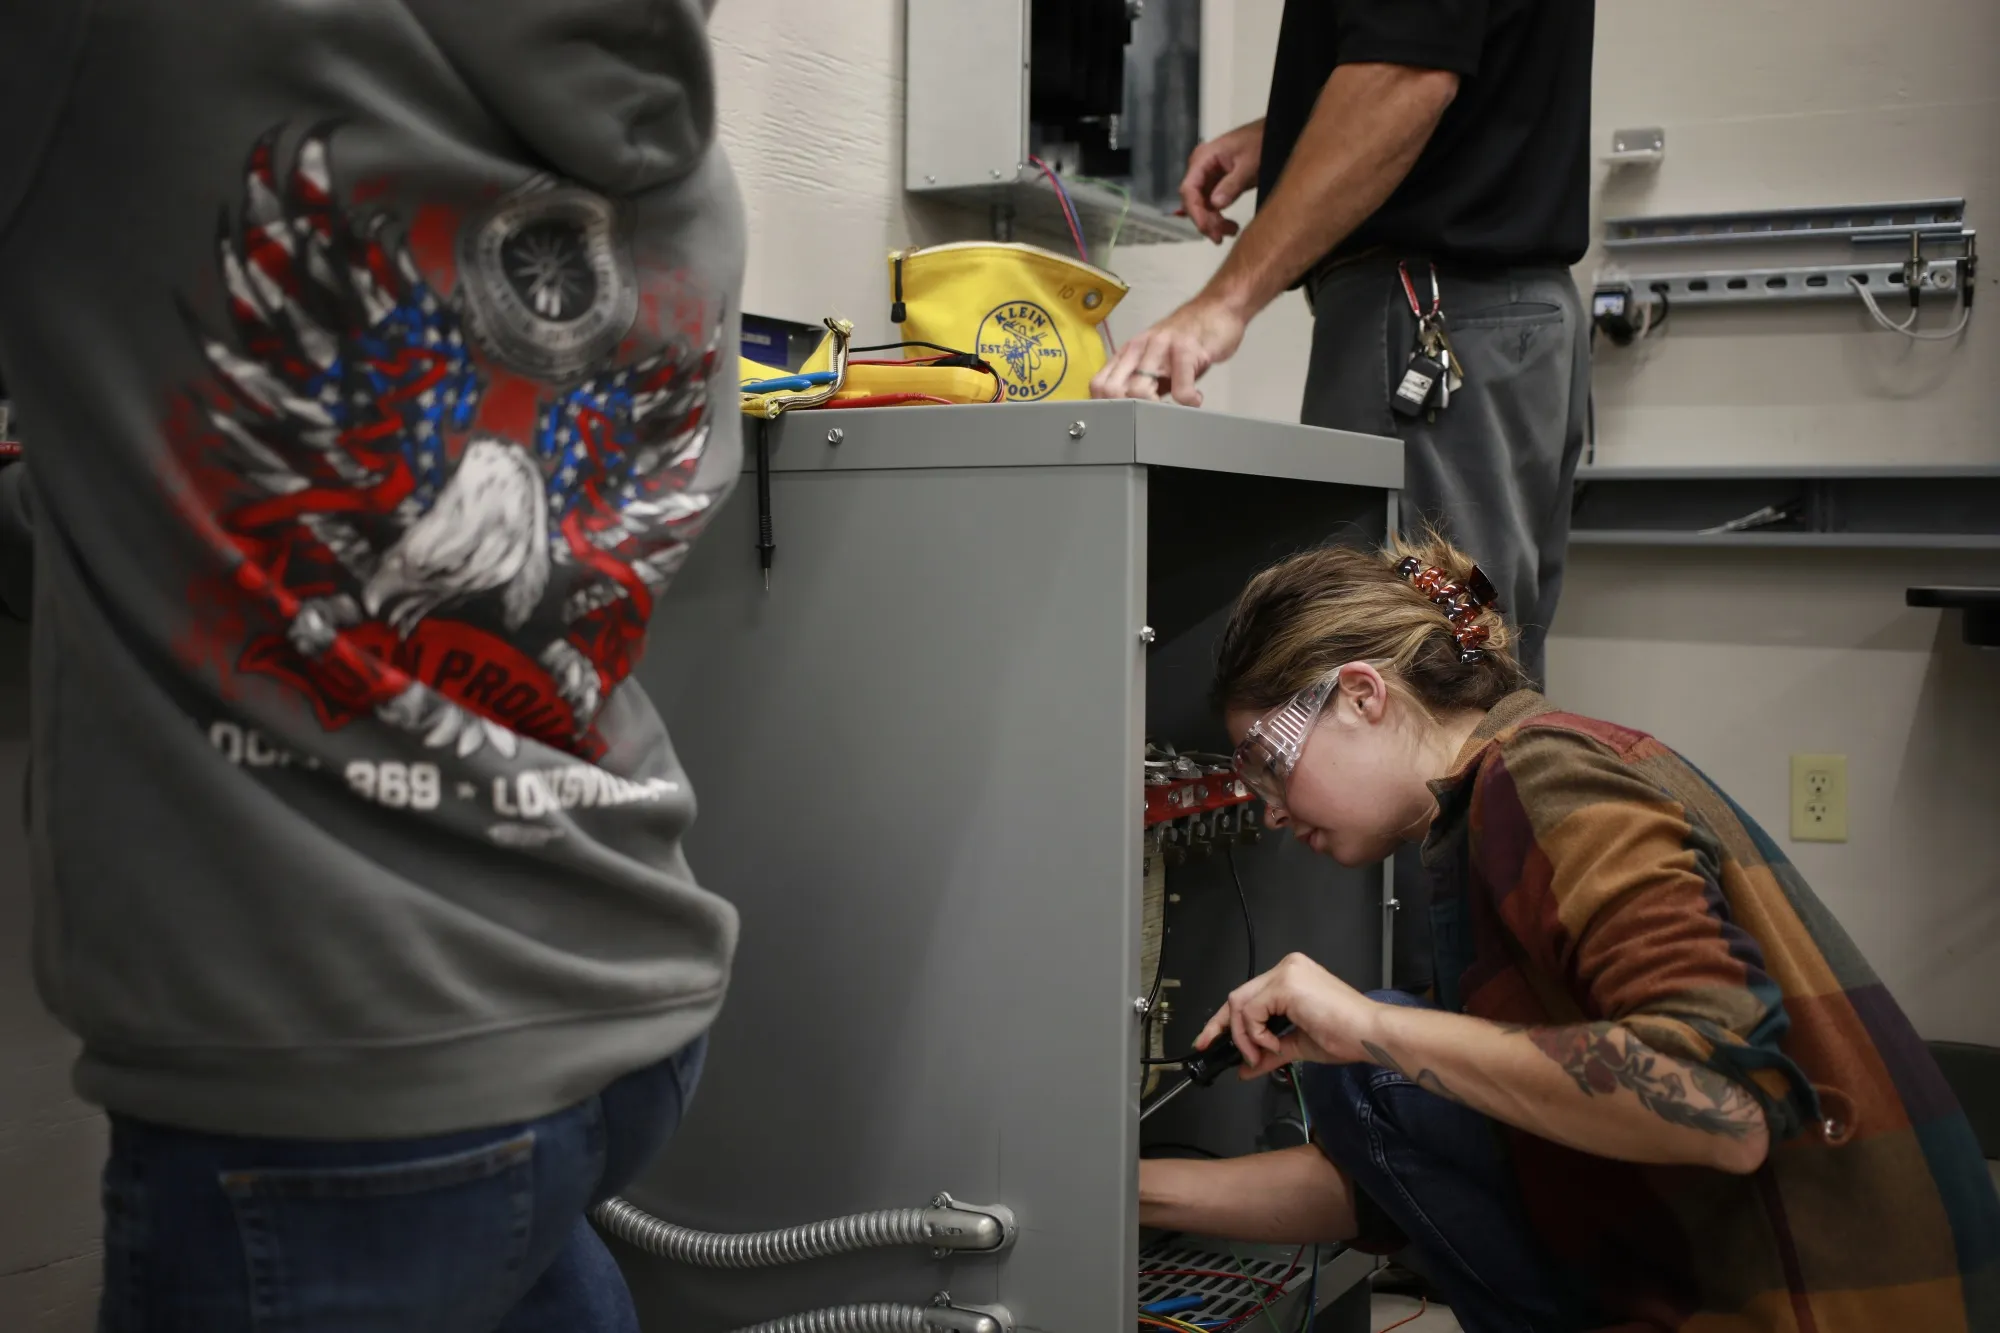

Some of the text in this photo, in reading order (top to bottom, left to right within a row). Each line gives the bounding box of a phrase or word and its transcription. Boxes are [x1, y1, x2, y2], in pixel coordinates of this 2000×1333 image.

[995, 306, 1046, 327] KLEIN
[1038, 348, 1062, 358] 1857
[430, 649, 568, 738] PROU
